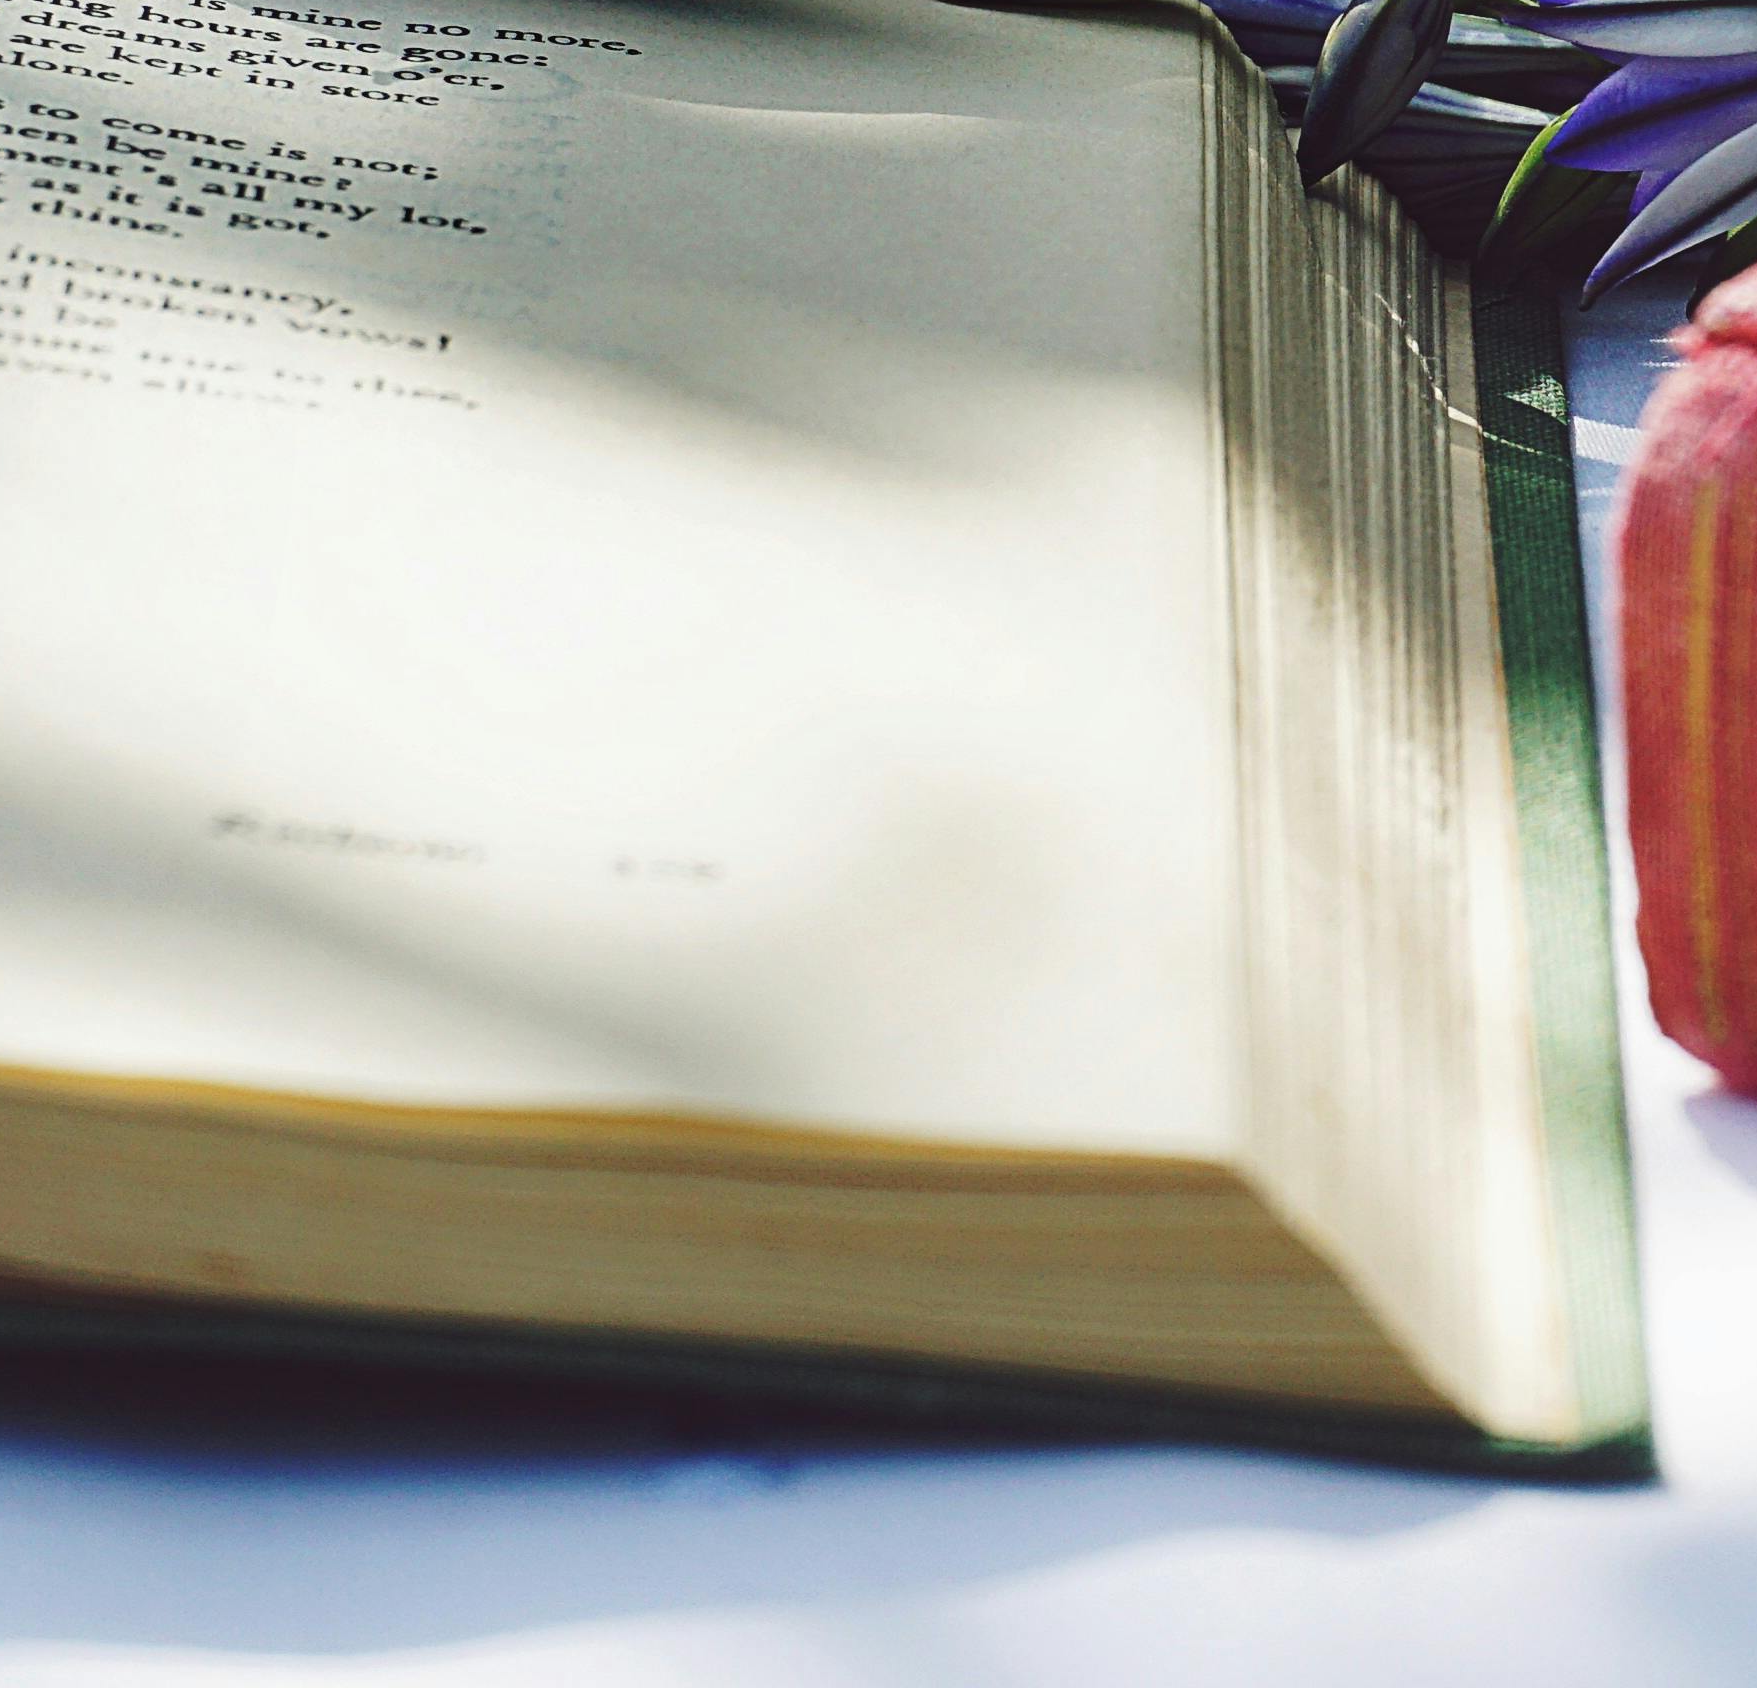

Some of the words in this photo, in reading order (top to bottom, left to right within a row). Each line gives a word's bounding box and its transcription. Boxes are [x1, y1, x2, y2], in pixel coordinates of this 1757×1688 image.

[20, 11, 207, 53] dreams
[227, 46, 373, 78] given
[136, 5, 283, 43] hours
[305, 36, 382, 55] are
[400, 45, 550, 68] gone:
[250, 6, 384, 32] mine
[403, 21, 471, 38] no
[493, 27, 644, 56] more,
[9, 34, 87, 55] are
[107, 45, 224, 79] kept
[243, 69, 296, 91] in
[320, 82, 441, 108] store
[28, 102, 80, 121] to
[101, 115, 248, 152] come
[267, 140, 309, 162] is
[331, 155, 440, 182] not;
[105, 135, 168, 162] be
[28, 176, 82, 195] as
[105, 184, 144, 207] it
[166, 195, 207, 217] is
[227, 210, 332, 240] got,
[30, 197, 186, 239] thine.
[200, 180, 268, 203] all
[292, 194, 380, 223] my
[400, 204, 490, 235] lot,
